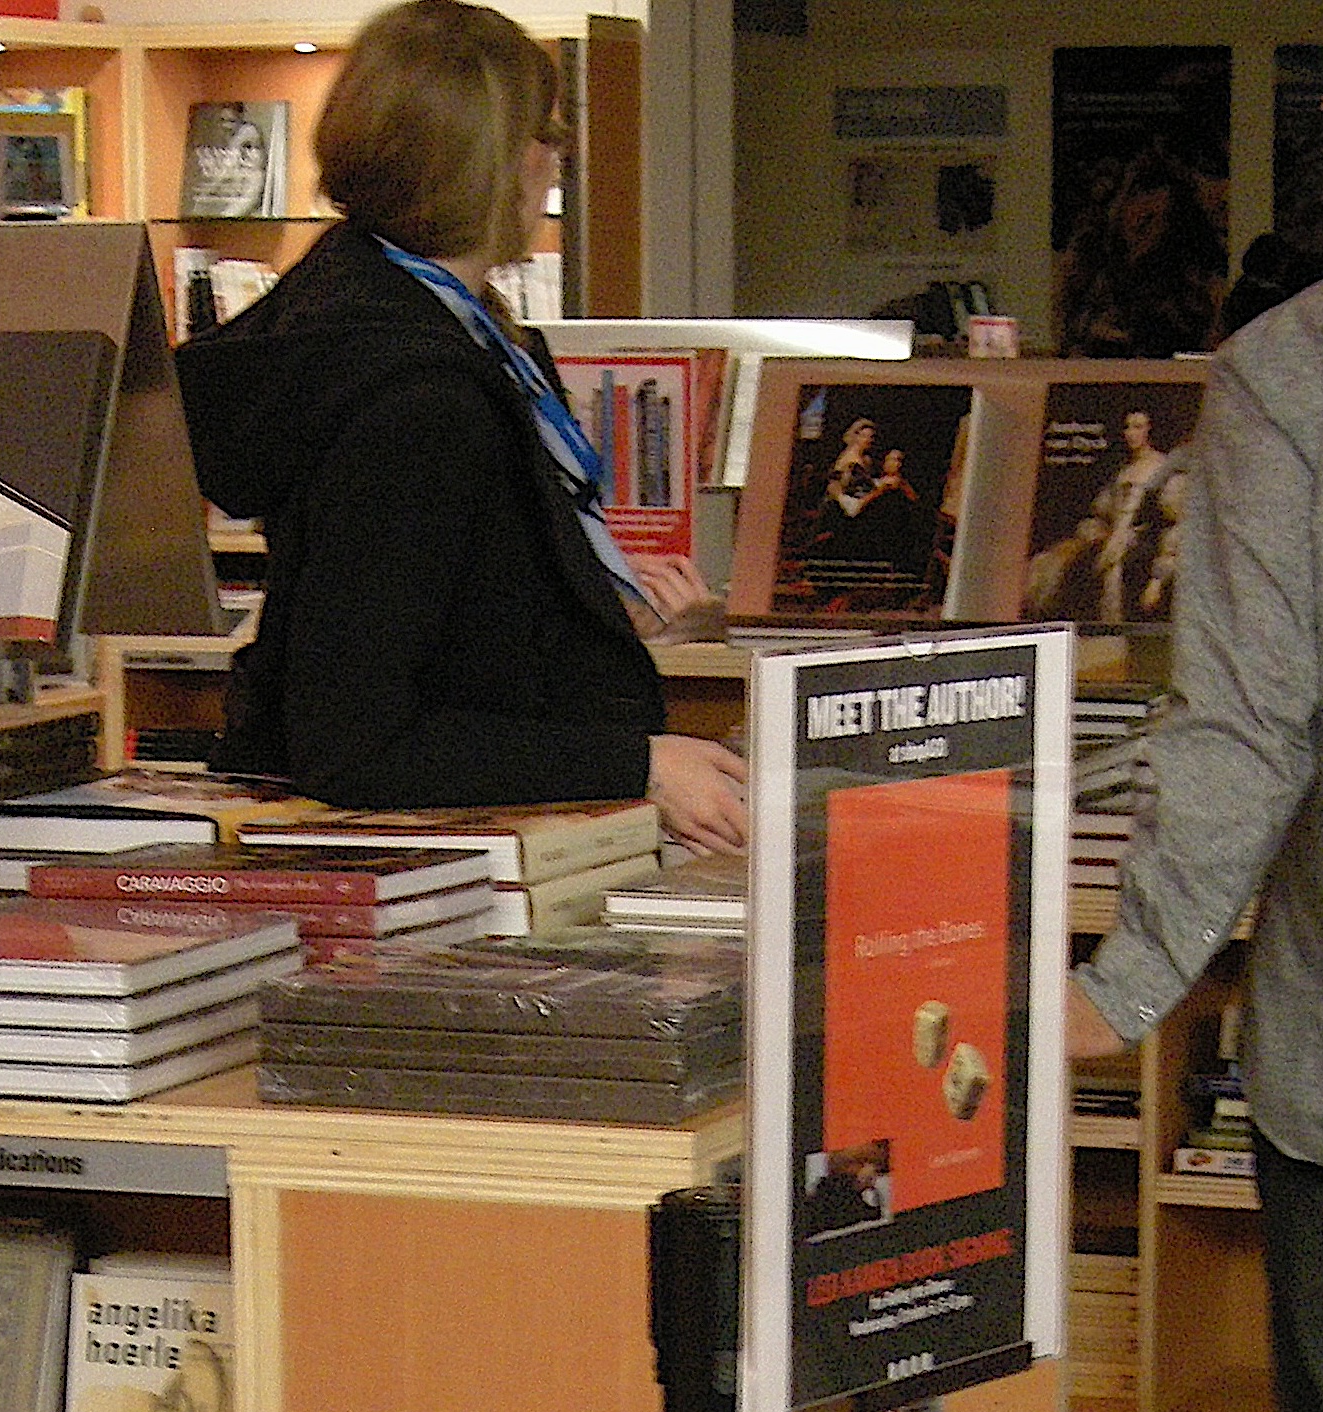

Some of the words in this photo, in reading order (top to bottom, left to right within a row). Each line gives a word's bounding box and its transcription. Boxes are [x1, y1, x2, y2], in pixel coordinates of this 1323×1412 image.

[807, 691, 876, 739] MEET
[877, 686, 927, 731] THE
[927, 676, 1025, 726] AUTHOR!
[116, 873, 228, 894] CARAVAGGIO
[855, 931, 912, 958] Rolling
[911, 929, 939, 950] the
[939, 920, 987, 945] Bones
[87, 1298, 218, 1336] angelika
[86, 1331, 180, 1370] hoerle
